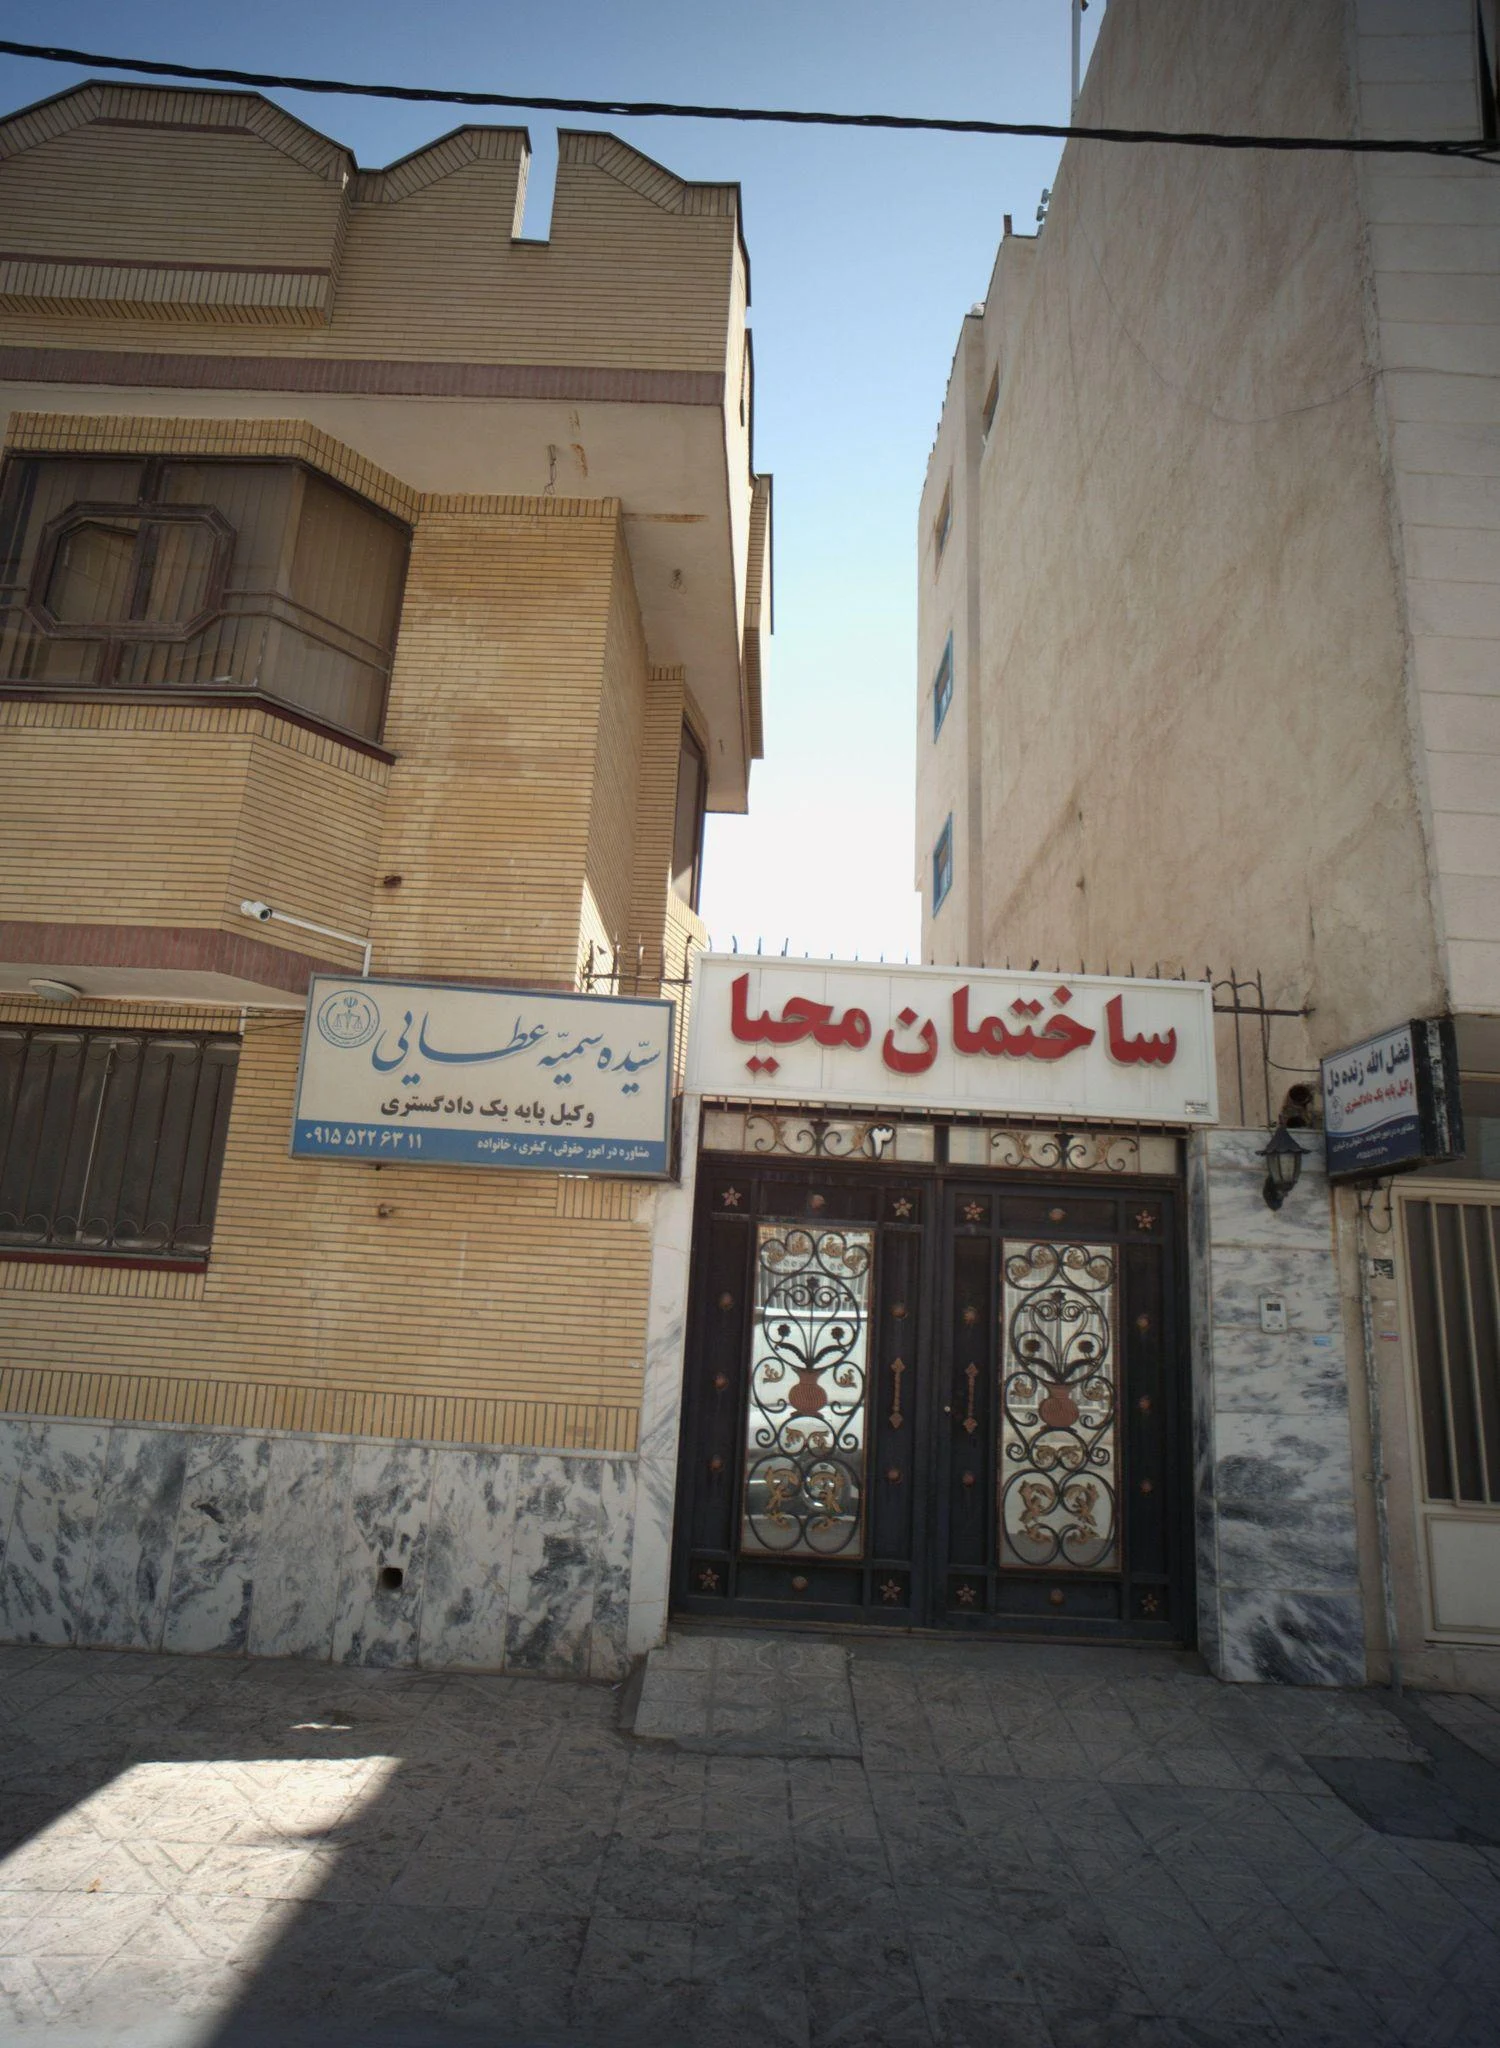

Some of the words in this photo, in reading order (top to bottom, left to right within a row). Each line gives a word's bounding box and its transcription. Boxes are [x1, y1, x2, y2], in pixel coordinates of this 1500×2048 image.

[731, 972, 872, 1075] محیا
[882, 984, 1177, 1076] ساختمان
[1366, 1047, 1383, 1073] الله
[1387, 1037, 1410, 1074] فضل
[380, 1095, 475, 1117] دادگستری
[479, 1098, 509, 1122] یک
[514, 1101, 546, 1126] پایه
[550, 1102, 595, 1128] وکیل
[305, 1126, 342, 1145] ۰۹۱۵
[408, 1133, 422, 1149] ۱۱
[477, 1137, 512, 1154] خانواده
[870, 1126, 895, 1159] ۳
[586, 1144, 605, 1159] امور
[606, 1145, 618, 1160] در
[618, 1144, 651, 1161] مشاوره
